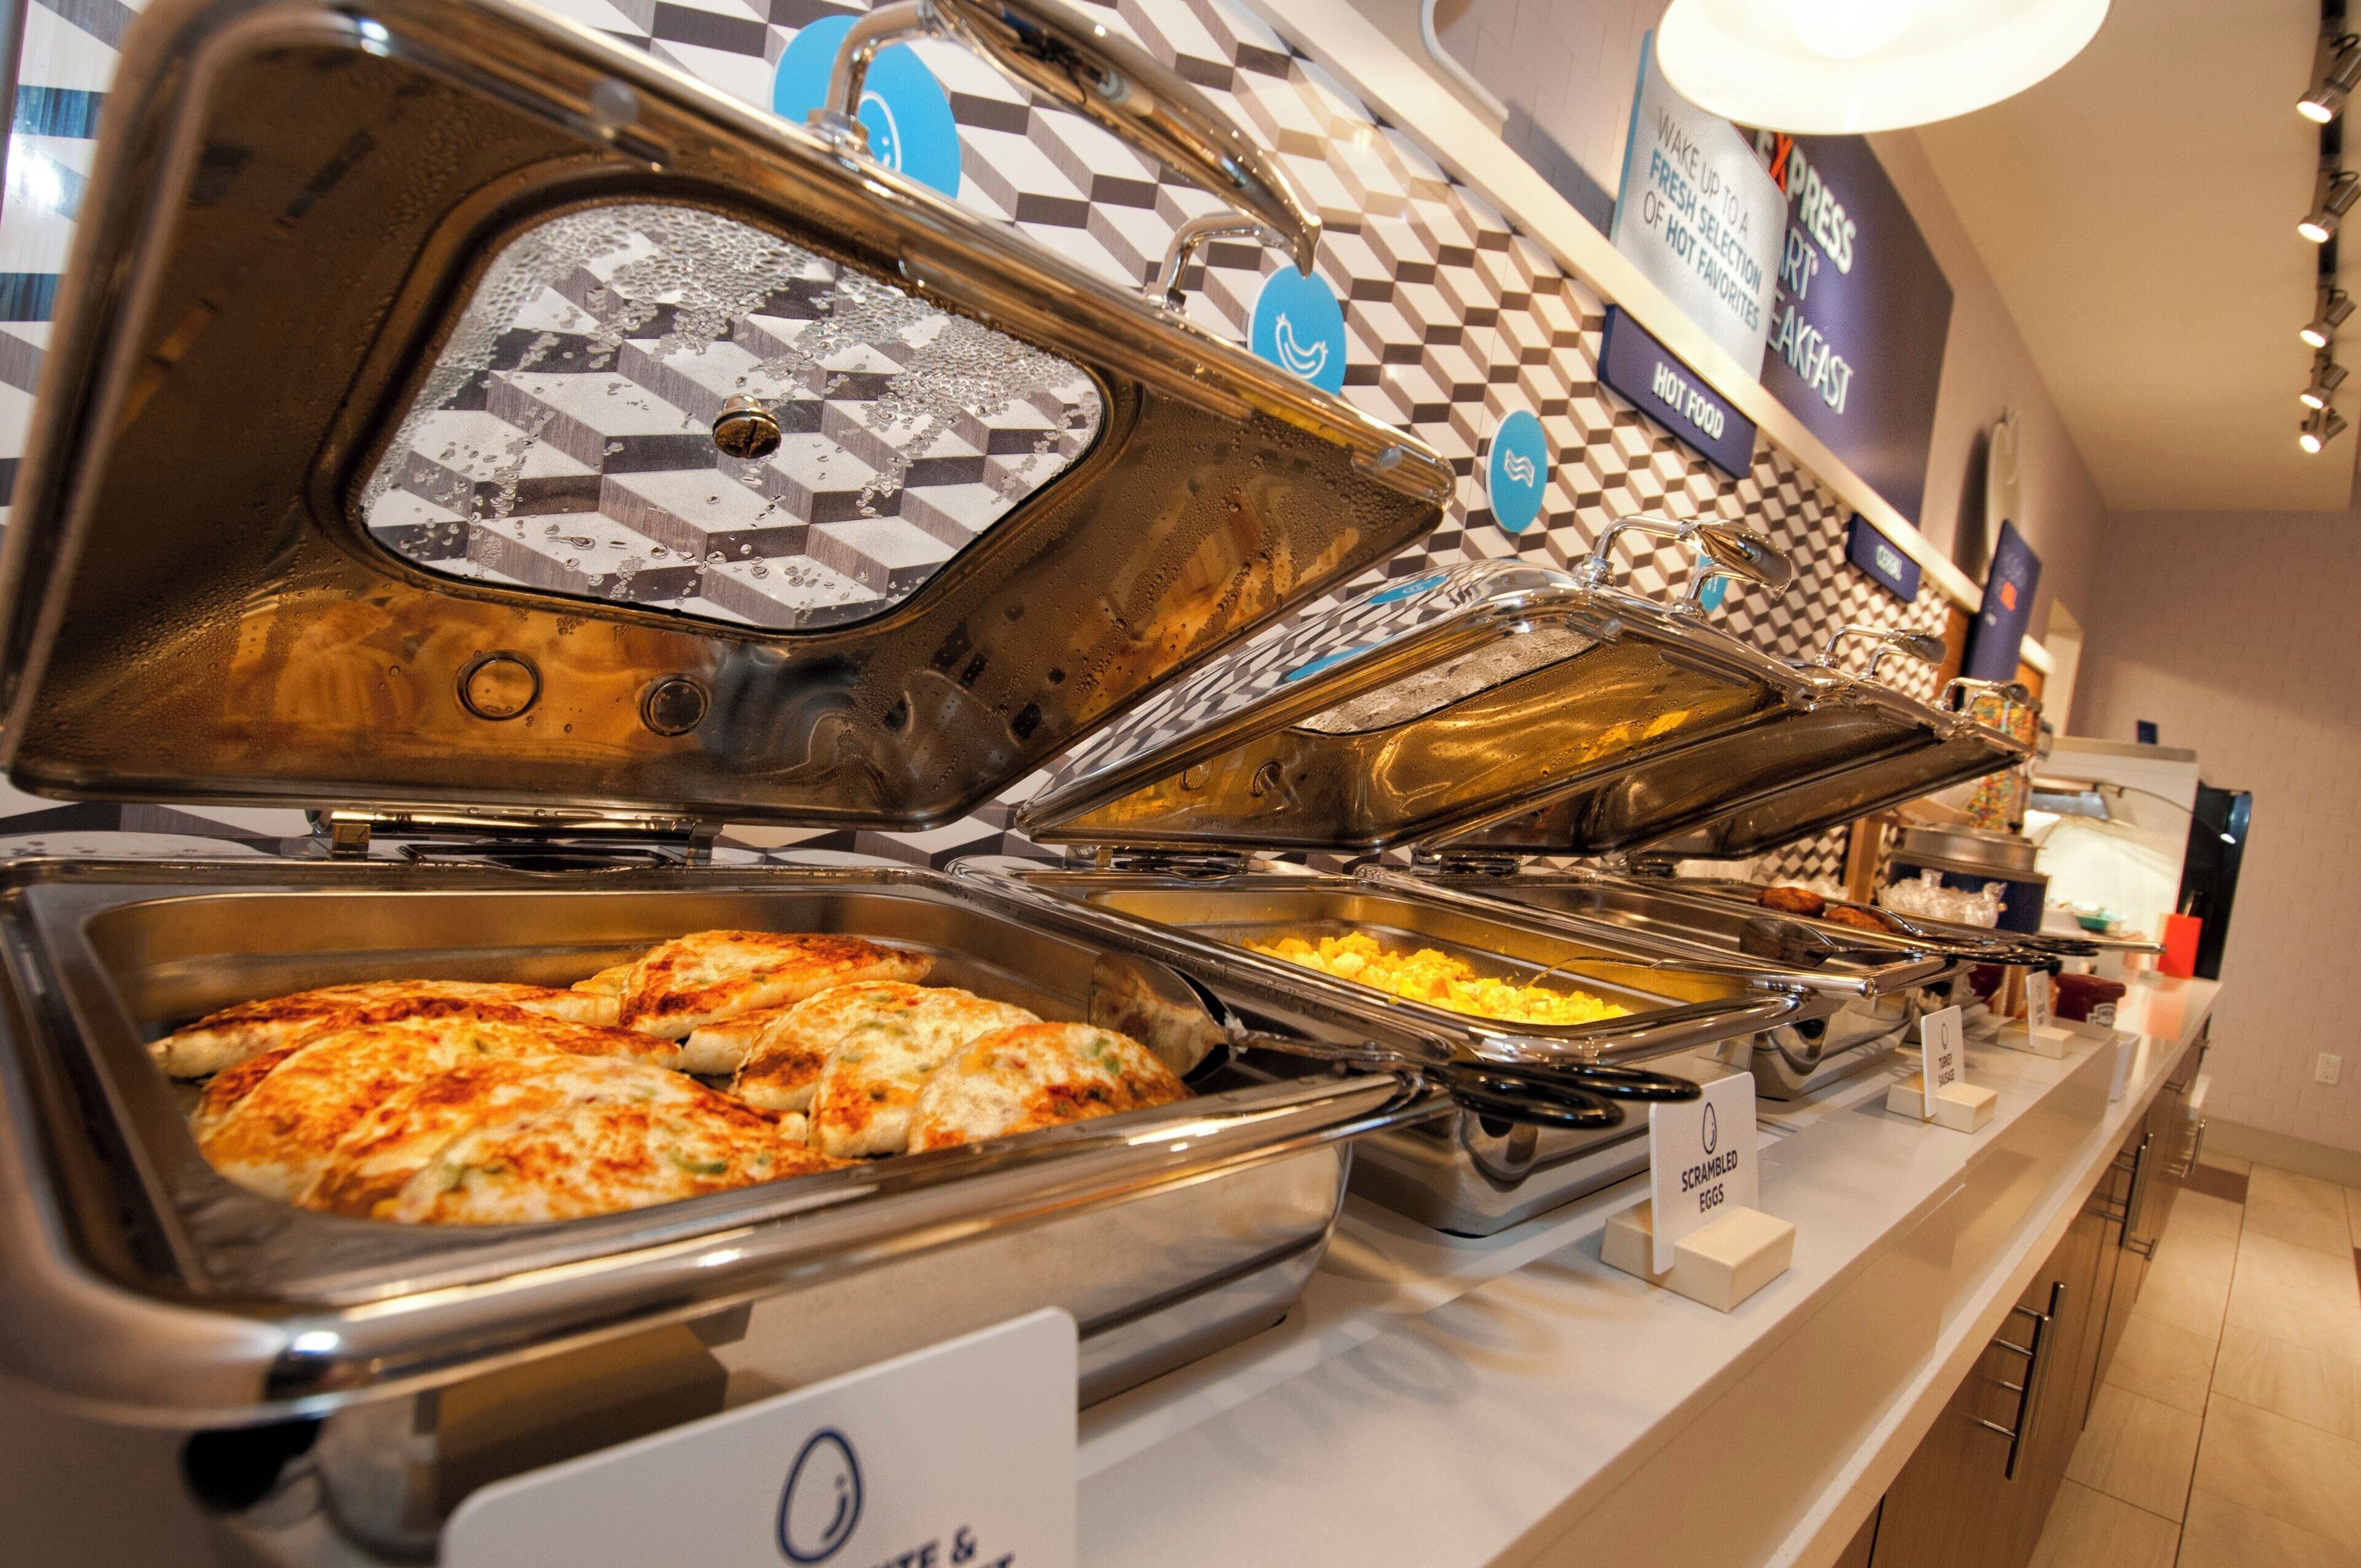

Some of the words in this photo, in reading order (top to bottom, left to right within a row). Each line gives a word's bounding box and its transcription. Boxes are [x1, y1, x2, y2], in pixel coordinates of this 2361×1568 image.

[1658, 106, 1700, 181] WAKE
[1701, 161, 1720, 198] UP
[1723, 184, 1739, 225] TO
[1739, 210, 1749, 240] A
[1650, 148, 1697, 223] FRESH
[1698, 205, 1763, 295] SELECTION
[1644, 191, 1666, 229] OF
[1666, 214, 1697, 264] HOT
[1697, 247, 1760, 331] FAVORITES
[1652, 362, 1688, 411] HOT
[1685, 389, 1724, 440] FOOD
[1682, 1150, 1738, 1192] SCRAMBLED
[1699, 1183, 1724, 1213] EGGS
[951, 1525, 976, 1567] &
